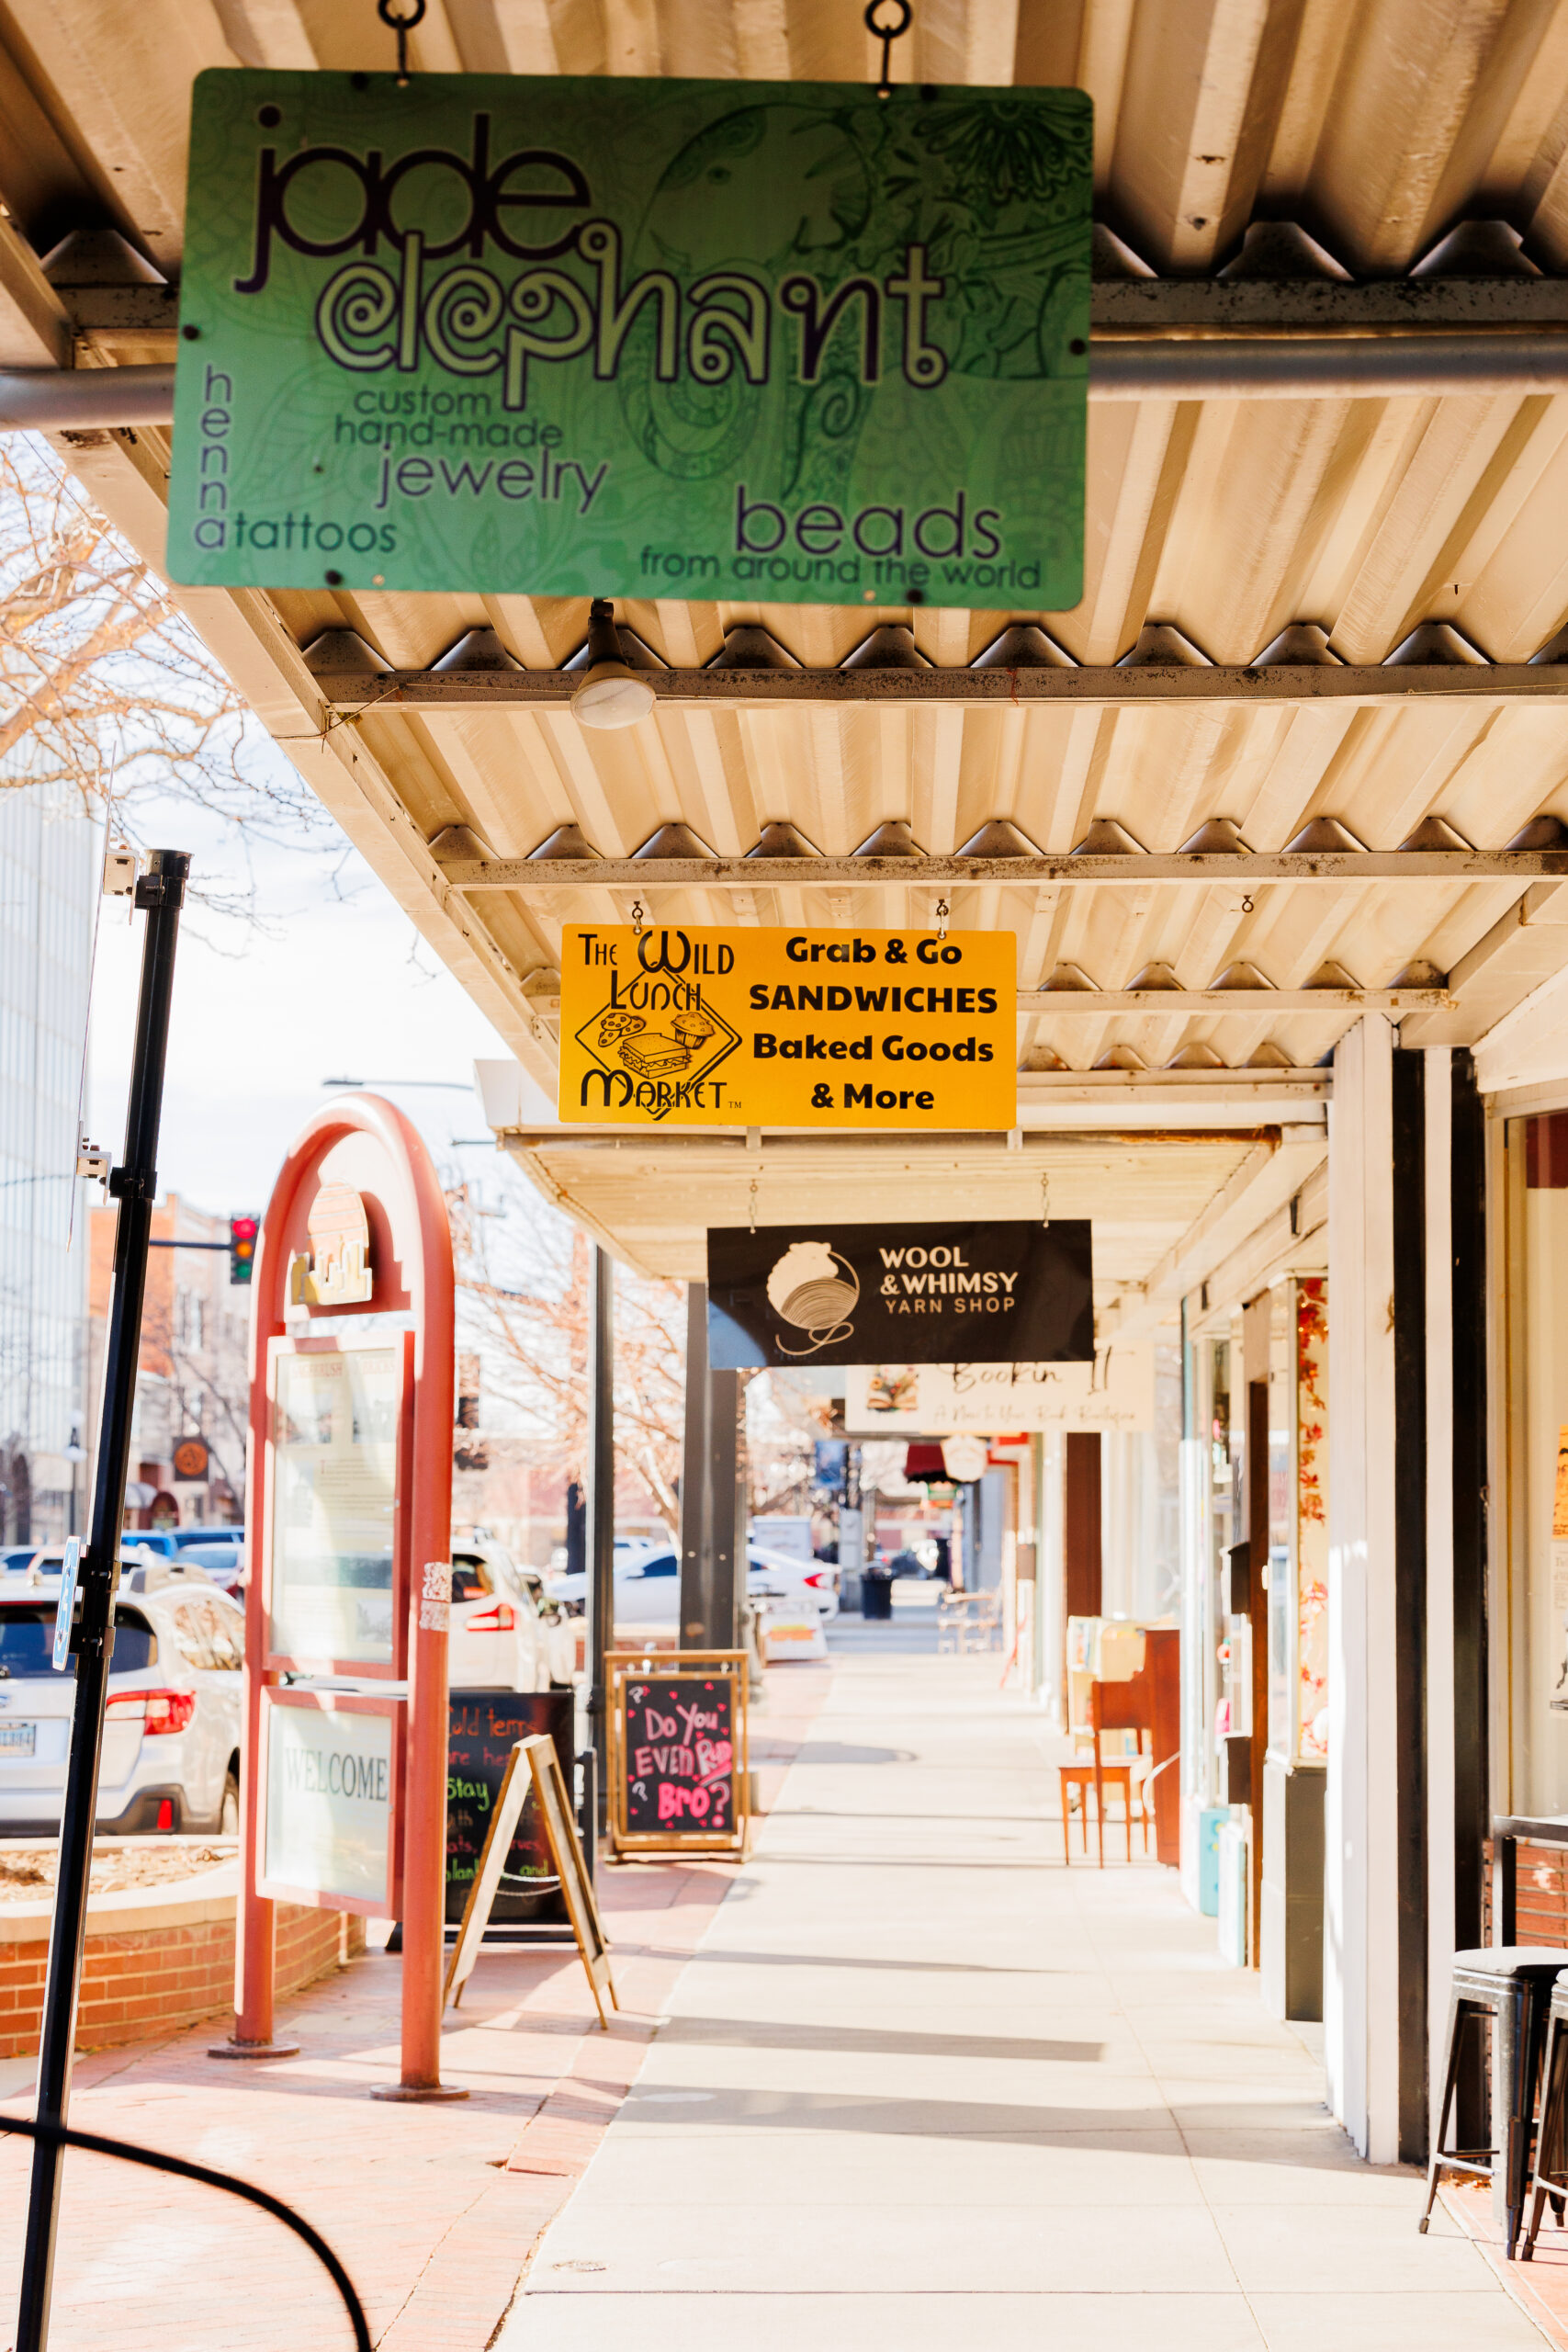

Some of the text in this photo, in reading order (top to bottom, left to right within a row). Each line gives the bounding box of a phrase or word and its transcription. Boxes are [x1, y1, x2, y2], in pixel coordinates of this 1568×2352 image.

[233, 105, 591, 293] jade
[315, 219, 948, 412] elephant
[354, 384, 491, 417] custom
[334, 413, 564, 448] hand-made
[194, 364, 232, 548] henna
[376, 442, 608, 514] jewelry
[234, 512, 397, 553] tattoos
[737, 484, 1001, 560] beads
[640, 545, 1041, 591] from around the world
[785, 936, 963, 965] Grab & Go
[749, 984, 998, 1013] SANDWICHES
[753, 1033, 994, 1062] Baked Goods
[811, 1082, 934, 1110] & More
[879, 1246, 969, 1269] WOOL
[886, 1296, 1015, 1314] YARN SHOP
[645, 1702, 718, 1747] Do You
[285, 1747, 388, 1802] WELCOME
[447, 1777, 490, 1812] Stay
[519, 1859, 548, 1876] and
